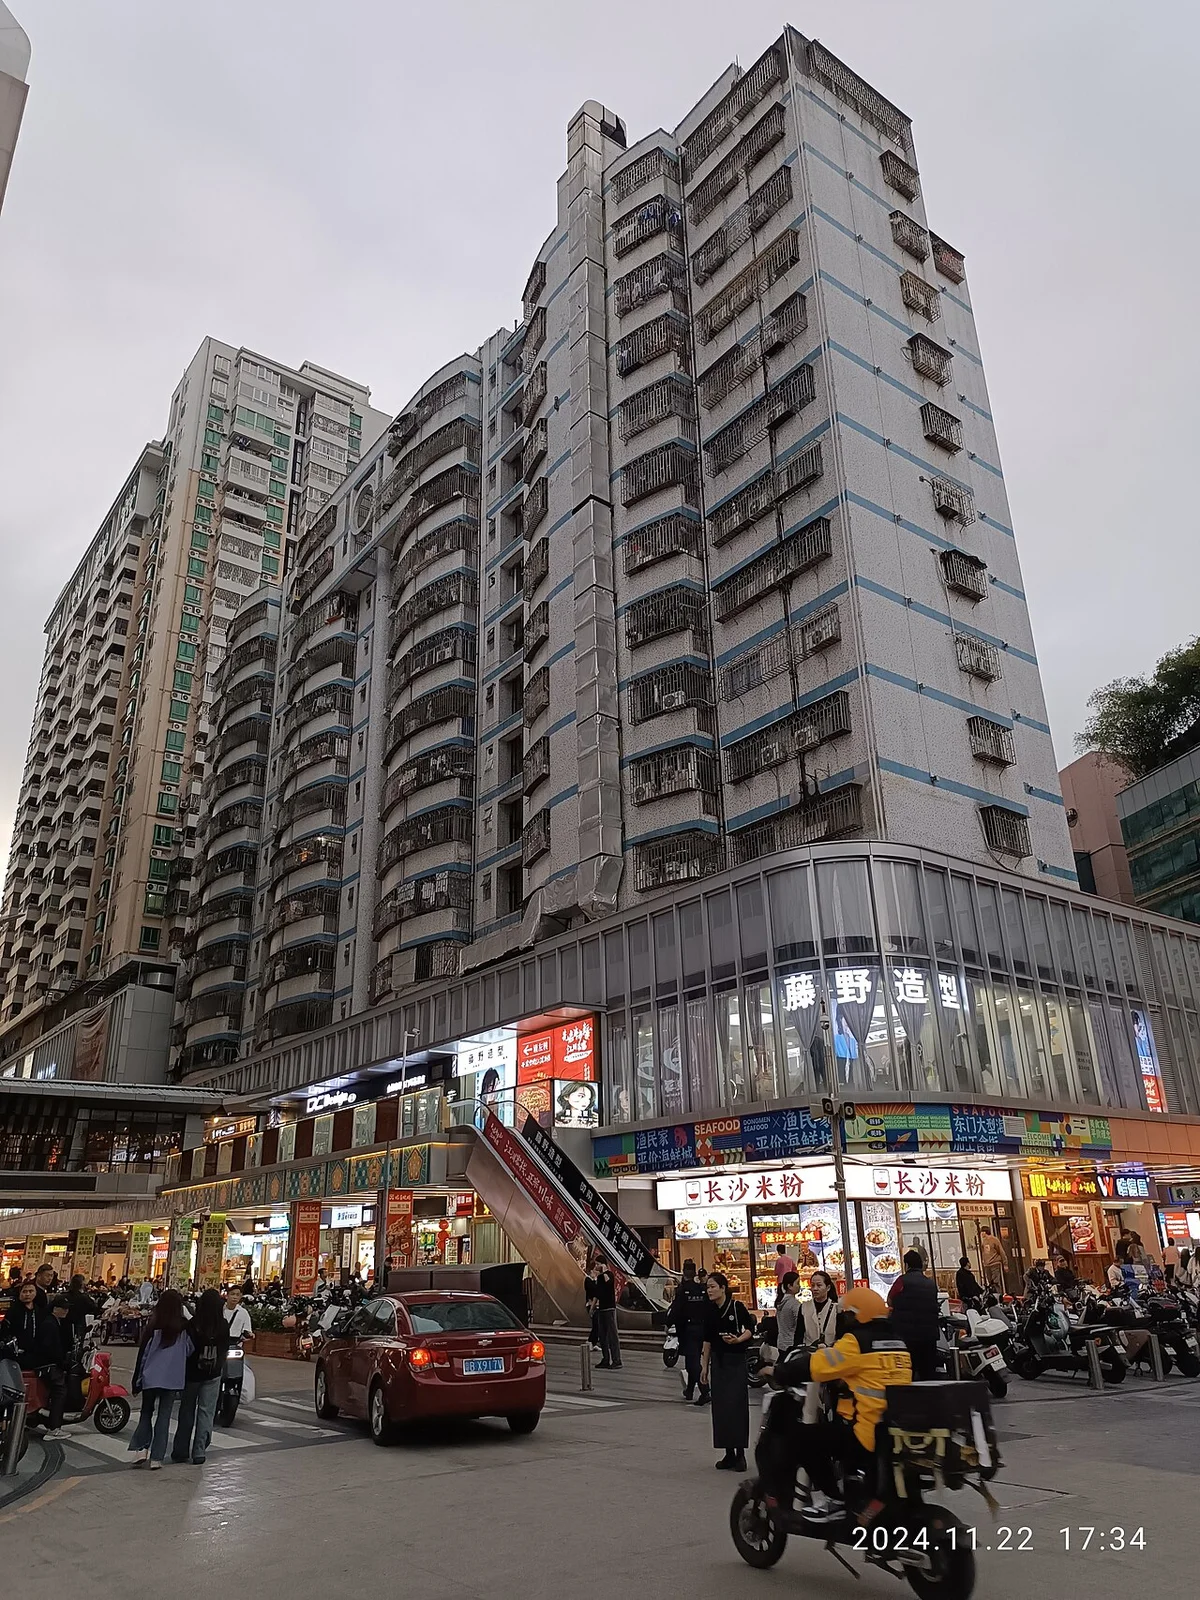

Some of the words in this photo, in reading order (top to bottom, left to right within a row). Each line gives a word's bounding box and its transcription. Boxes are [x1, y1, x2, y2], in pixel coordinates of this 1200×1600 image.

[783, 969, 960, 1011] 藤野造型
[743, 1116, 771, 1127] DONGMEN
[952, 1105, 1015, 1117] SEAFOOD
[694, 1118, 741, 1136] SEAFOOD
[743, 1123, 769, 1133] SEAFOOD
[535, 1130, 563, 1168] 藤野造型
[636, 1129, 669, 1150] 渔民家
[637, 1146, 694, 1168] 平价海鲜城
[1020, 1147, 1048, 1155] WELCOME
[704, 1173, 805, 1203] 长沙米粉
[894, 1170, 986, 1197] 长沙米粉
[600, 1222, 639, 1271] 请上二楼
[614, 1221, 645, 1262] 形象设计
